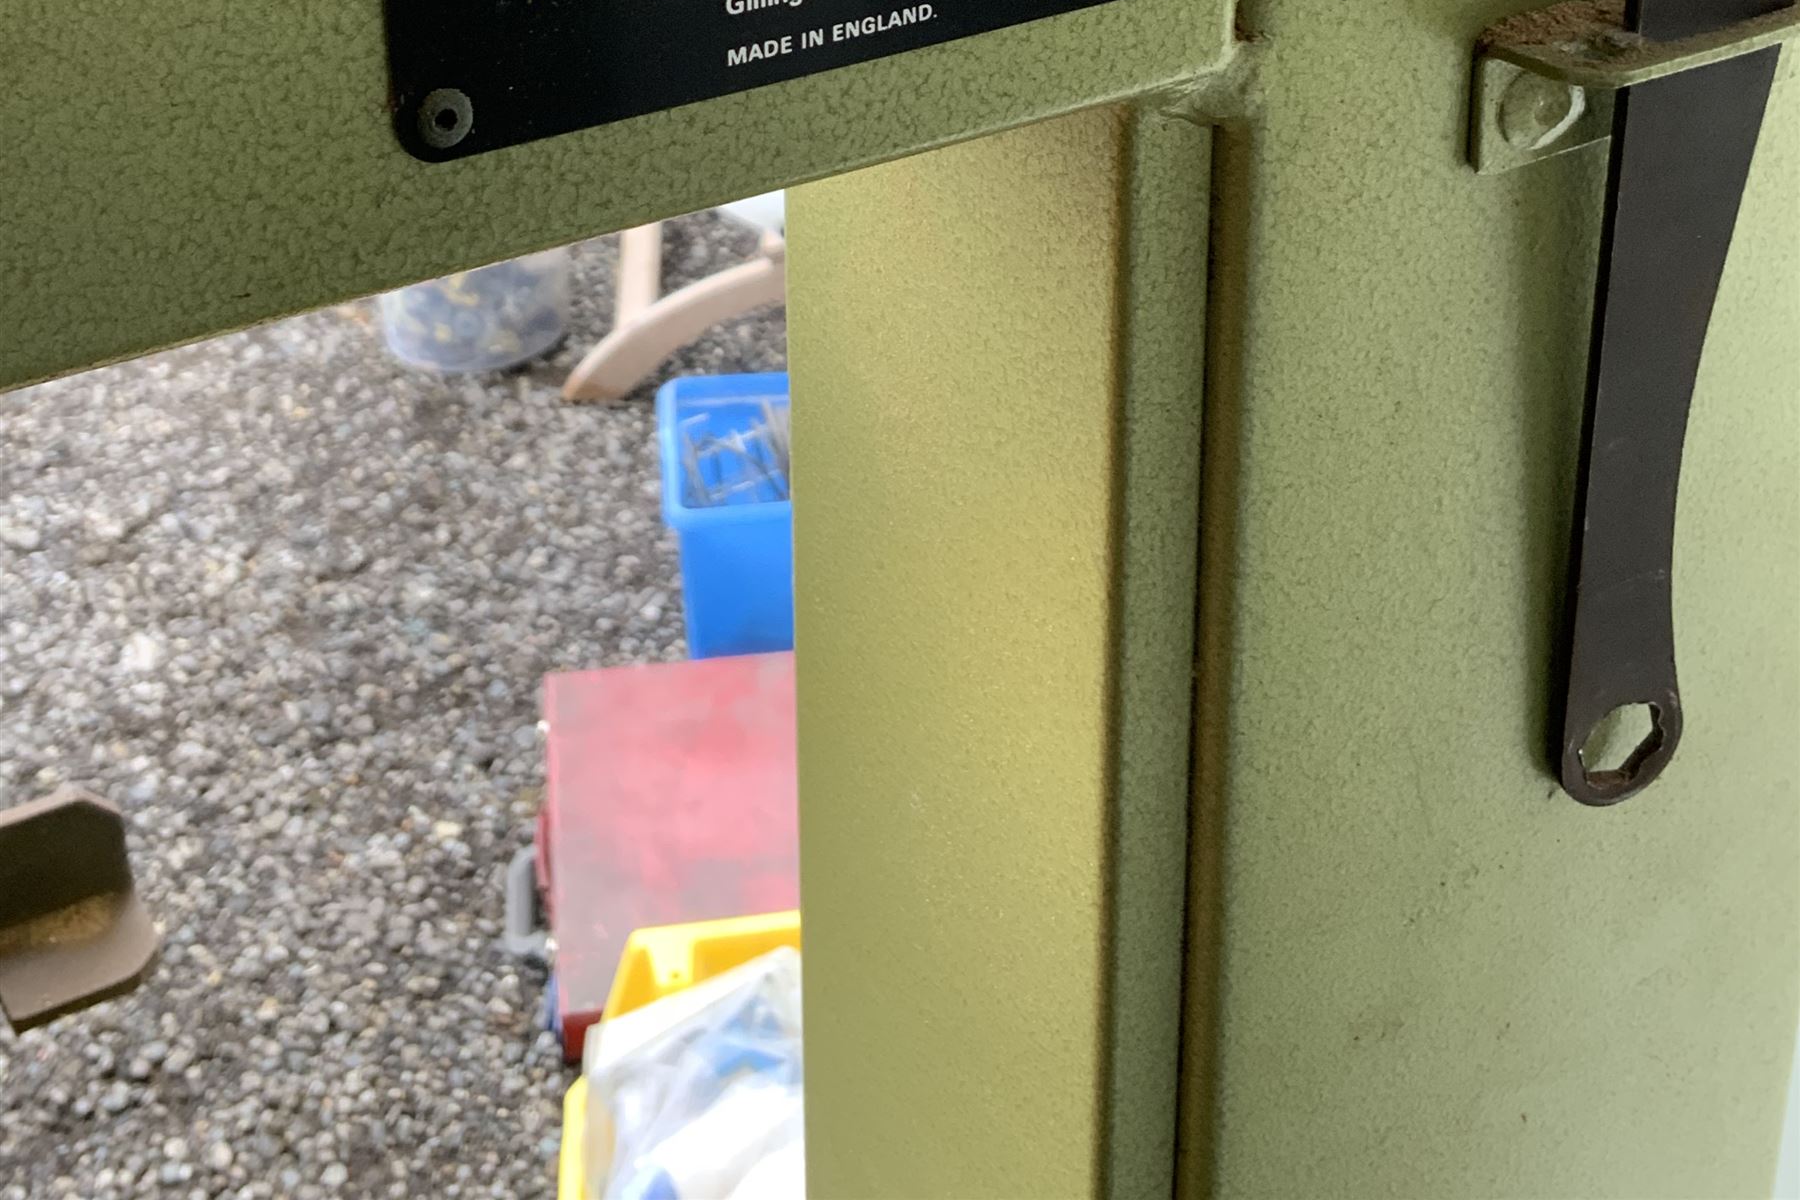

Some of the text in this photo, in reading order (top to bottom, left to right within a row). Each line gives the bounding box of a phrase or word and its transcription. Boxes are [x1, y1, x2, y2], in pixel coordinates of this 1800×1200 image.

[727, 3, 938, 66] MADE IN ENGLAND.
